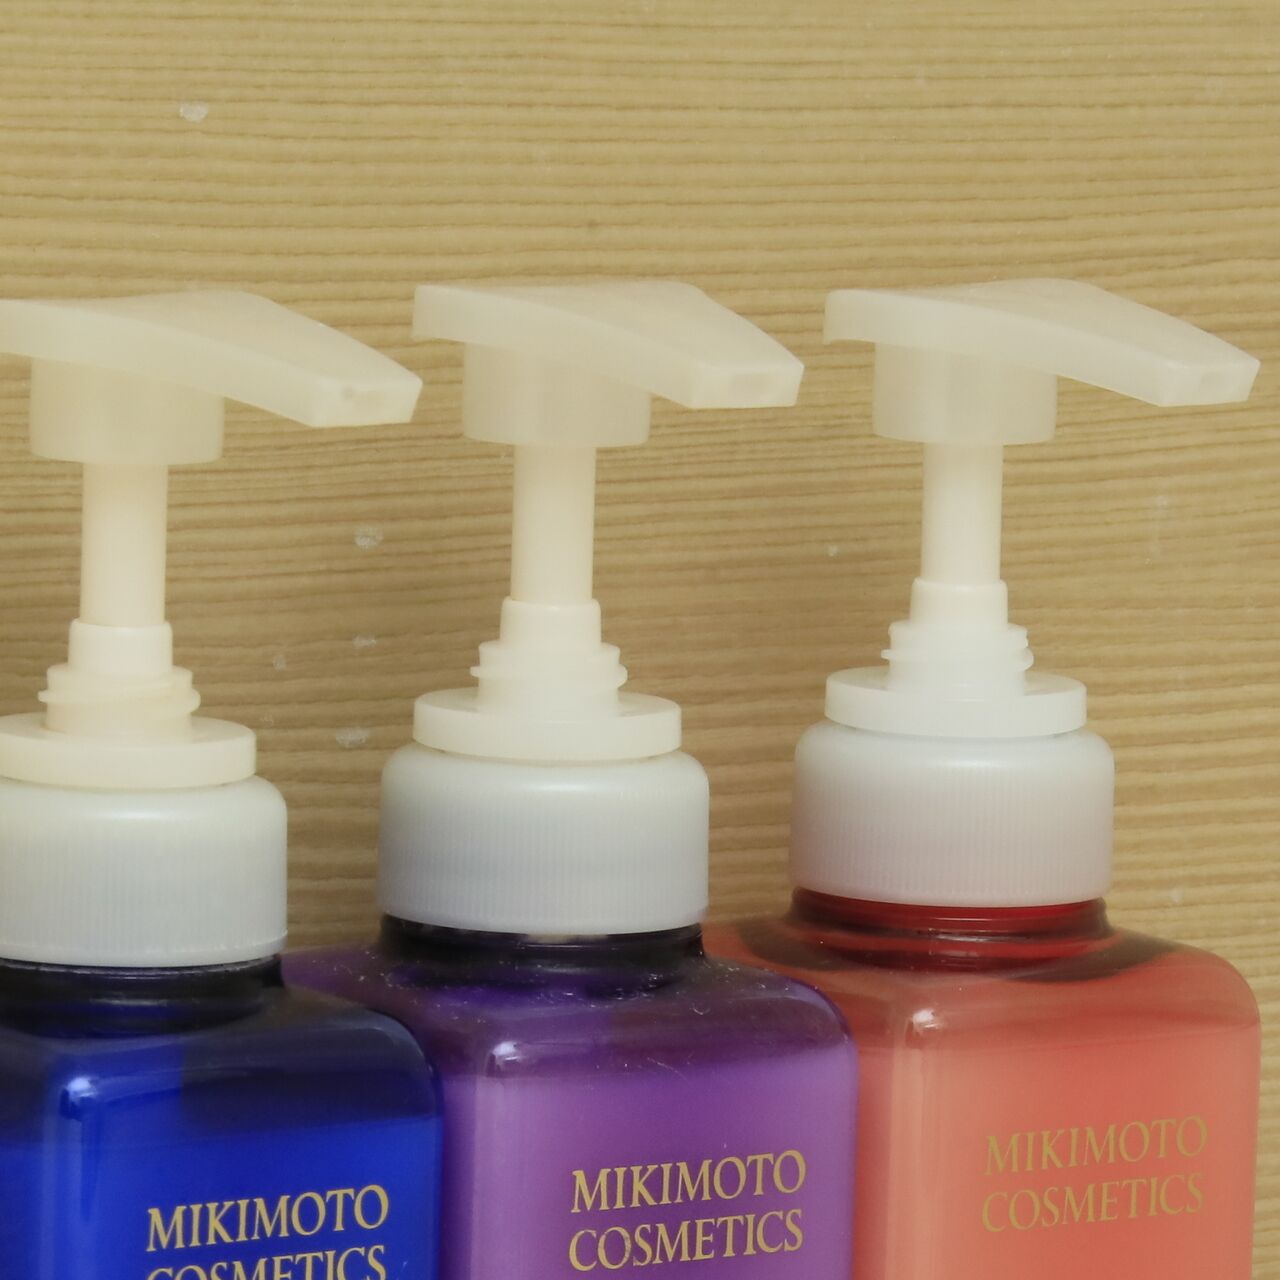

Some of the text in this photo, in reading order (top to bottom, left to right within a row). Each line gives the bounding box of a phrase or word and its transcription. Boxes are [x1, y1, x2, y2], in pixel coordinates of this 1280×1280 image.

[983, 1114, 1209, 1176] MIKIMOTO
[570, 1149, 807, 1213] MIKIMOTO
[981, 1172, 1204, 1233] COSMETICS
[145, 1184, 390, 1252] MIKIMOTO
[569, 1208, 804, 1272] COSMETICS
